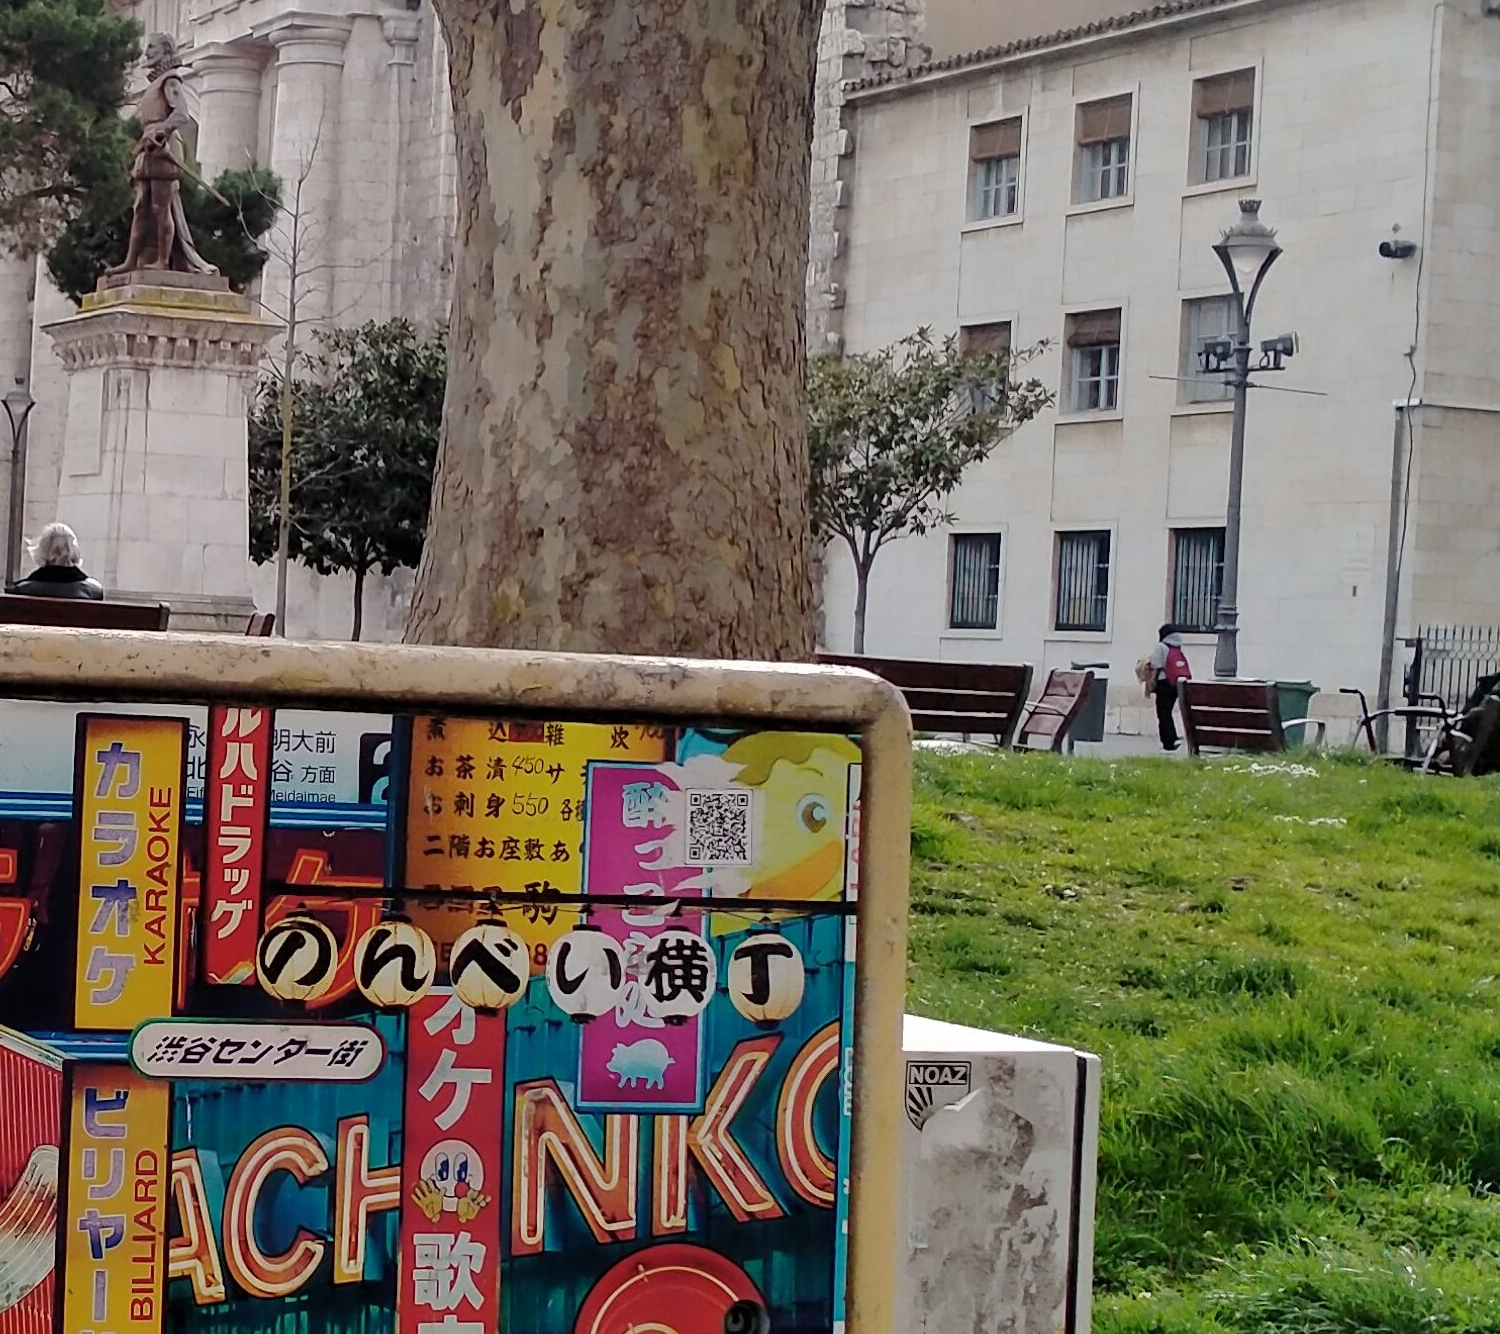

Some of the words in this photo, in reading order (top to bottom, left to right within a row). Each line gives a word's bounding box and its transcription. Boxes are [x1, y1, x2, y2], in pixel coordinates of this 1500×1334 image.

[301, 765, 336, 784] 方面
[86, 742, 142, 1006] カラオケ
[143, 786, 172, 966] KARAOKE
[423, 835, 585, 863] 二階お座敷あ
[258, 917, 794, 1006] のんべい横丁
[146, 1034, 371, 1069] 渋谷センター街
[910, 1066, 967, 1085] NOAZ
[130, 1149, 158, 1321] BILLIARD
